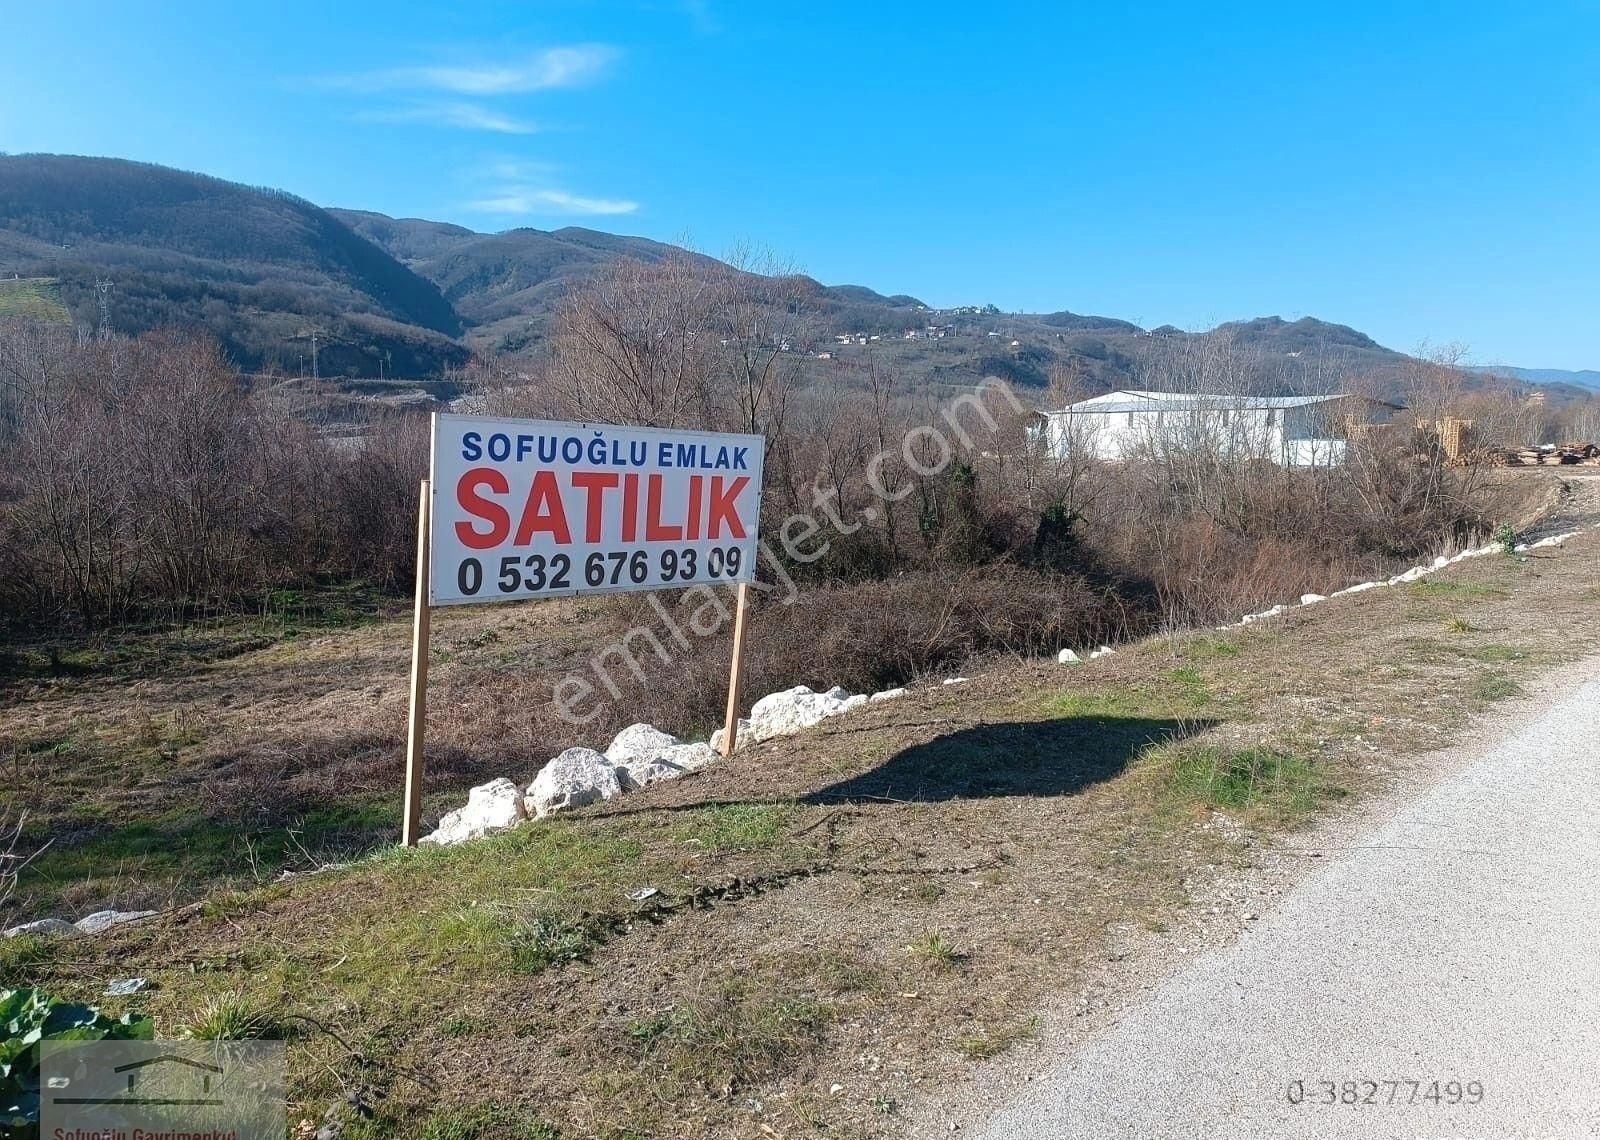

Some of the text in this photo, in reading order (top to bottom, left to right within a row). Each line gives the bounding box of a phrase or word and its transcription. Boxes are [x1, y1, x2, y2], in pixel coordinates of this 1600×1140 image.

[462, 431, 748, 470] SOFUOĞLU EMLAK
[454, 467, 751, 549] SATILIK
[458, 546, 741, 595] 0 532 676 93 09
